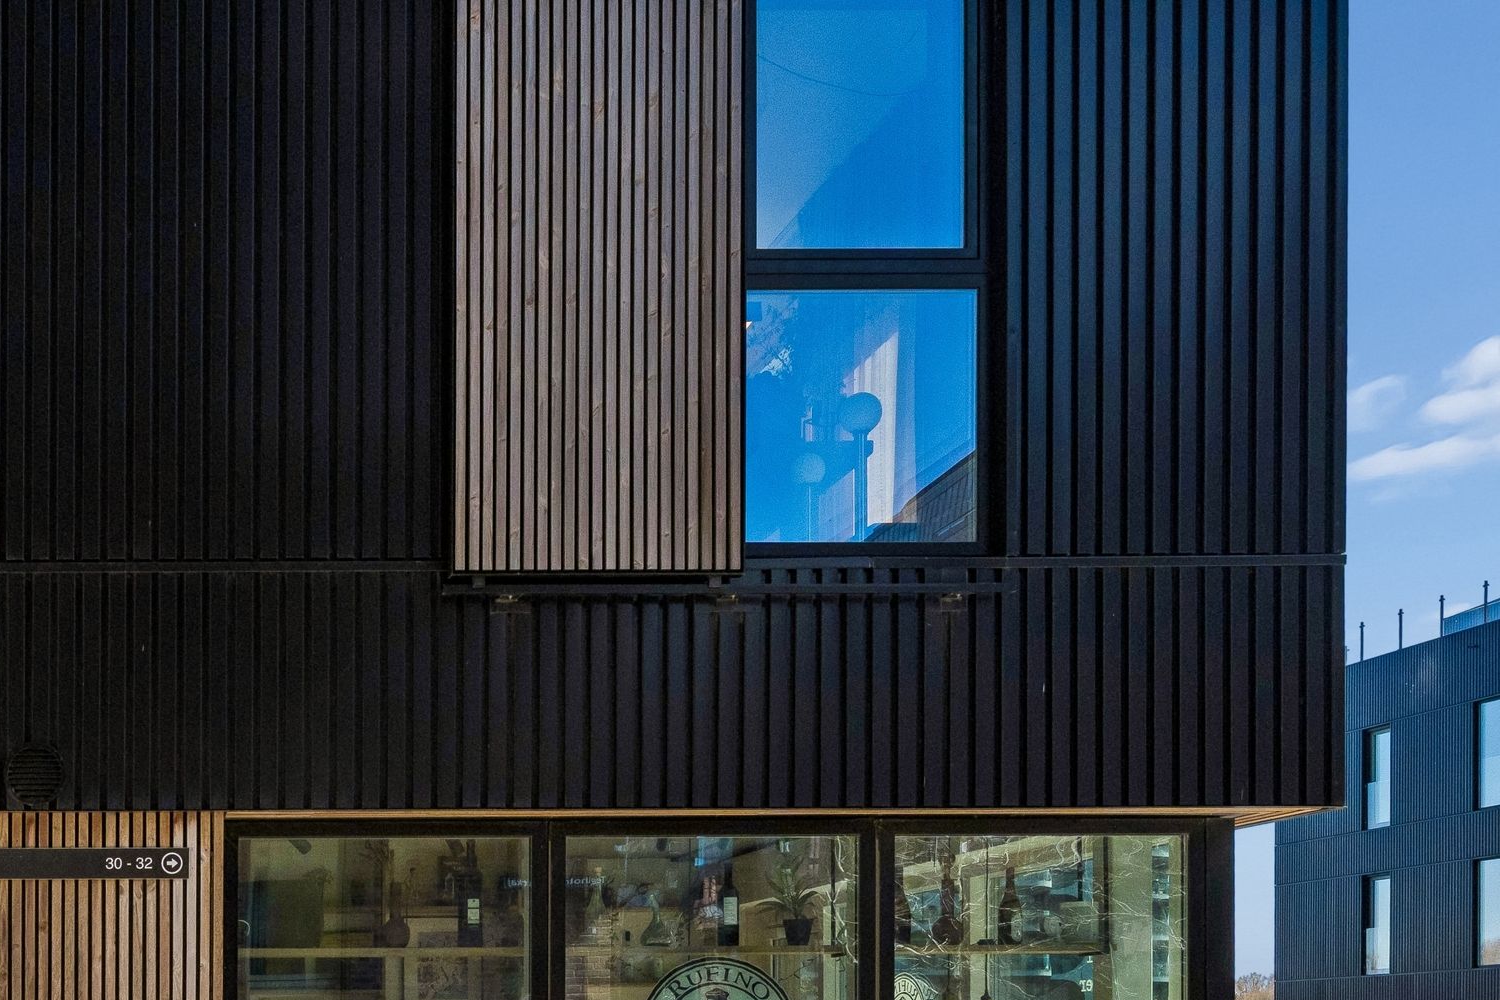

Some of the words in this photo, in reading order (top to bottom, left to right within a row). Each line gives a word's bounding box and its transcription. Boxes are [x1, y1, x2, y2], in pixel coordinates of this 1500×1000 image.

[105, 857, 123, 870] 30
[135, 857, 153, 870] 32
[666, 965, 770, 1000] RUFINO
